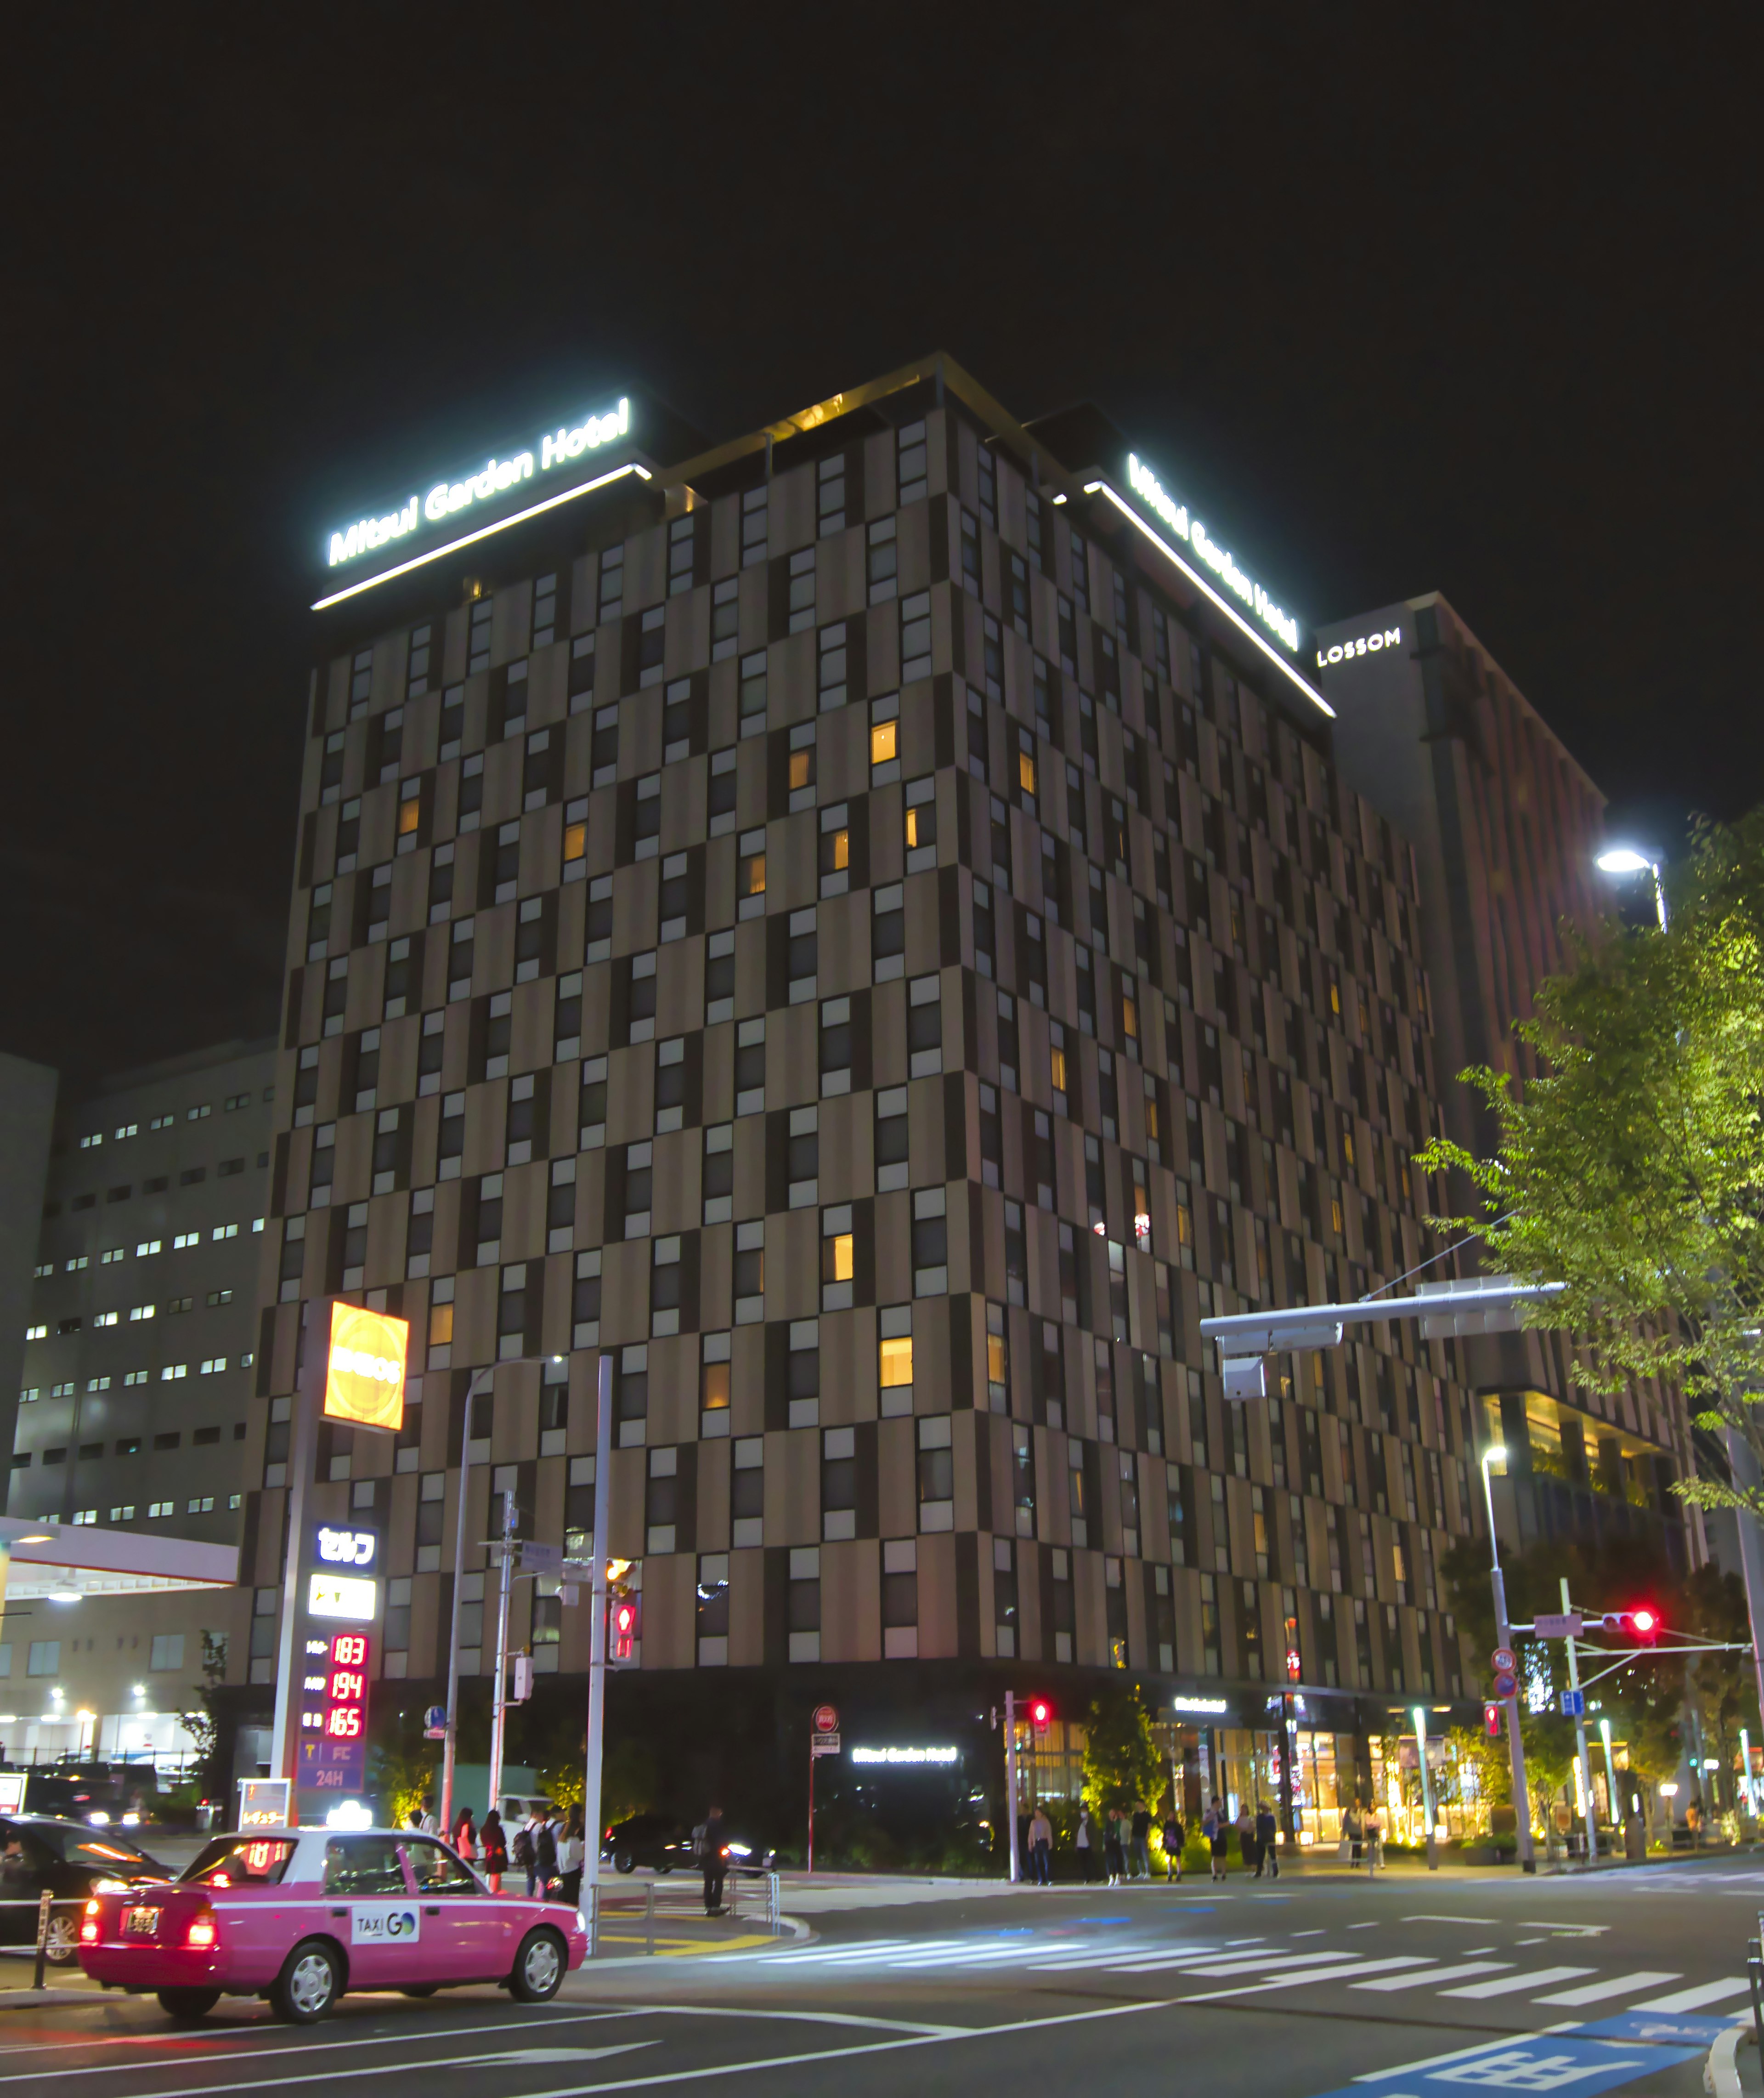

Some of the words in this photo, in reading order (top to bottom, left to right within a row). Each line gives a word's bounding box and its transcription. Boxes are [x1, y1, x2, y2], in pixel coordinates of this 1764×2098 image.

[425, 453, 533, 520] Garden
[542, 398, 628, 469] Hotel
[1317, 627, 1400, 667] LOSSOM
[318, 1528, 374, 1565] セルフ
[334, 1637, 365, 1664] 183
[332, 1672, 362, 1699] 194
[329, 1708, 359, 1735] 165
[316, 1770, 343, 1786] 24H
[357, 1918, 384, 1933] TAXI
